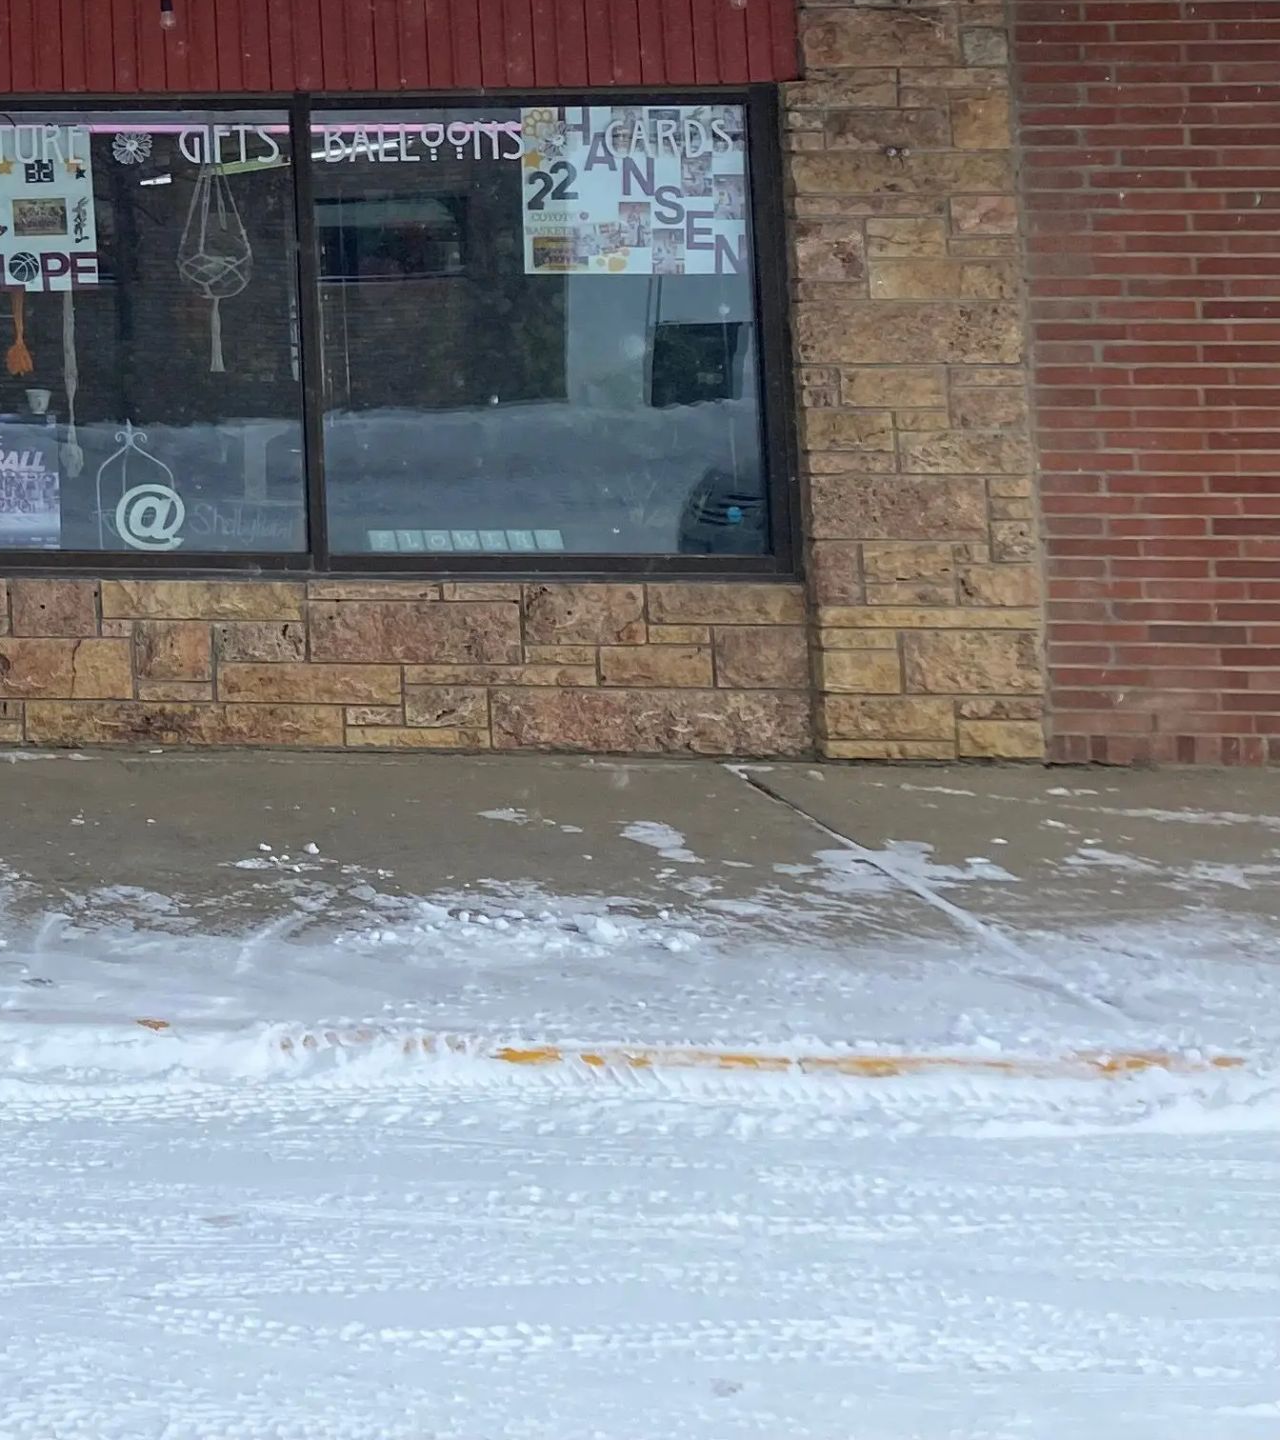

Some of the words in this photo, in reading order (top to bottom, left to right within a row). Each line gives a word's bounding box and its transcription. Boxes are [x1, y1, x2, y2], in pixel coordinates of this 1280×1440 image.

[178, 124, 281, 164] GIFTS
[323, 120, 525, 163] BALLOONS
[604, 118, 734, 159] CARDS
